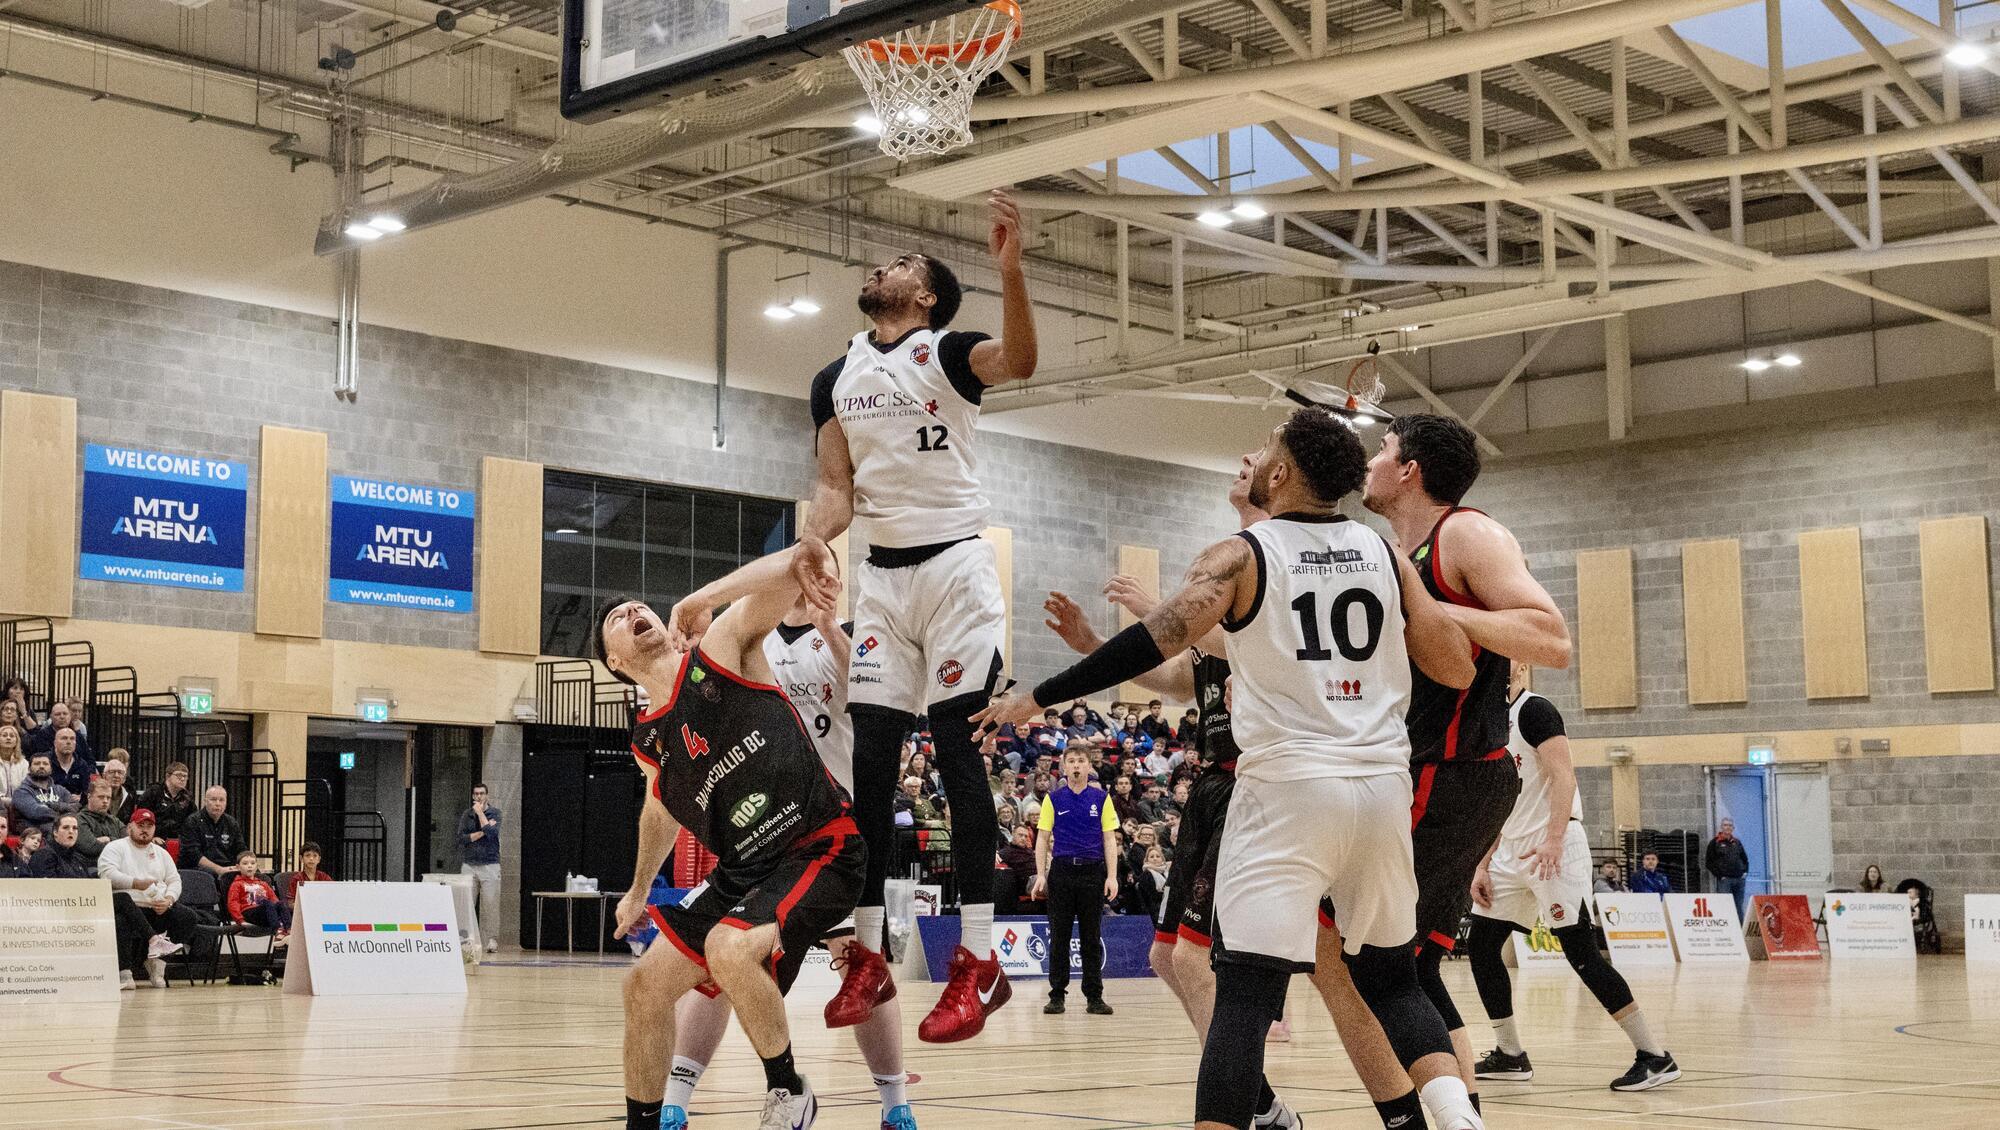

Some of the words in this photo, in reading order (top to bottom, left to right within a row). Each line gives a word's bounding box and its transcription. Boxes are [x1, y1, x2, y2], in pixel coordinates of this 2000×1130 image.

[836, 393, 885, 414] UPMC
[863, 410, 897, 420] SURGERY
[916, 425, 949, 452] 12
[105, 448, 200, 477] WELCOME
[206, 462, 231, 480] TO
[350, 480, 433, 506] WELCOME
[438, 492, 460, 509] TO
[134, 496, 199, 521] MTU
[112, 516, 218, 545] ARENA
[375, 525, 432, 547] MTU
[356, 544, 449, 570] ARENA
[103, 565, 225, 585] www.mtuarena.ie
[1287, 564, 1333, 575] GRIFFITH
[1335, 562, 1379, 574] COLLEGE
[349, 589, 455, 608] www.mtuarena.ie
[1291, 587, 1385, 662] 10
[852, 661, 881, 669] Domino's
[789, 683, 817, 697] SSC
[814, 714, 831, 738] 9
[643, 728, 657, 747] vive
[681, 723, 710, 760] 4
[742, 730, 766, 754] BC
[752, 830, 759, 838] &
[782, 801, 799, 815] Ltd.
[758, 813, 802, 847] CONTRACTORS
[11, 896, 77, 907] Investments
[79, 896, 97, 907] Ltd
[2, 925, 49, 935] FINANCIAL
[52, 925, 95, 934] ADVISORS
[1684, 919, 1704, 927] JERRY
[1706, 919, 1729, 927] LYNCH
[8, 940, 64, 949] INVESTMENTS
[65, 940, 96, 948] BROKER
[324, 940, 344, 954] Pat
[348, 939, 413, 953] McDonnell
[416, 939, 451, 953] Paints
[999, 960, 1029, 968] Domino's
